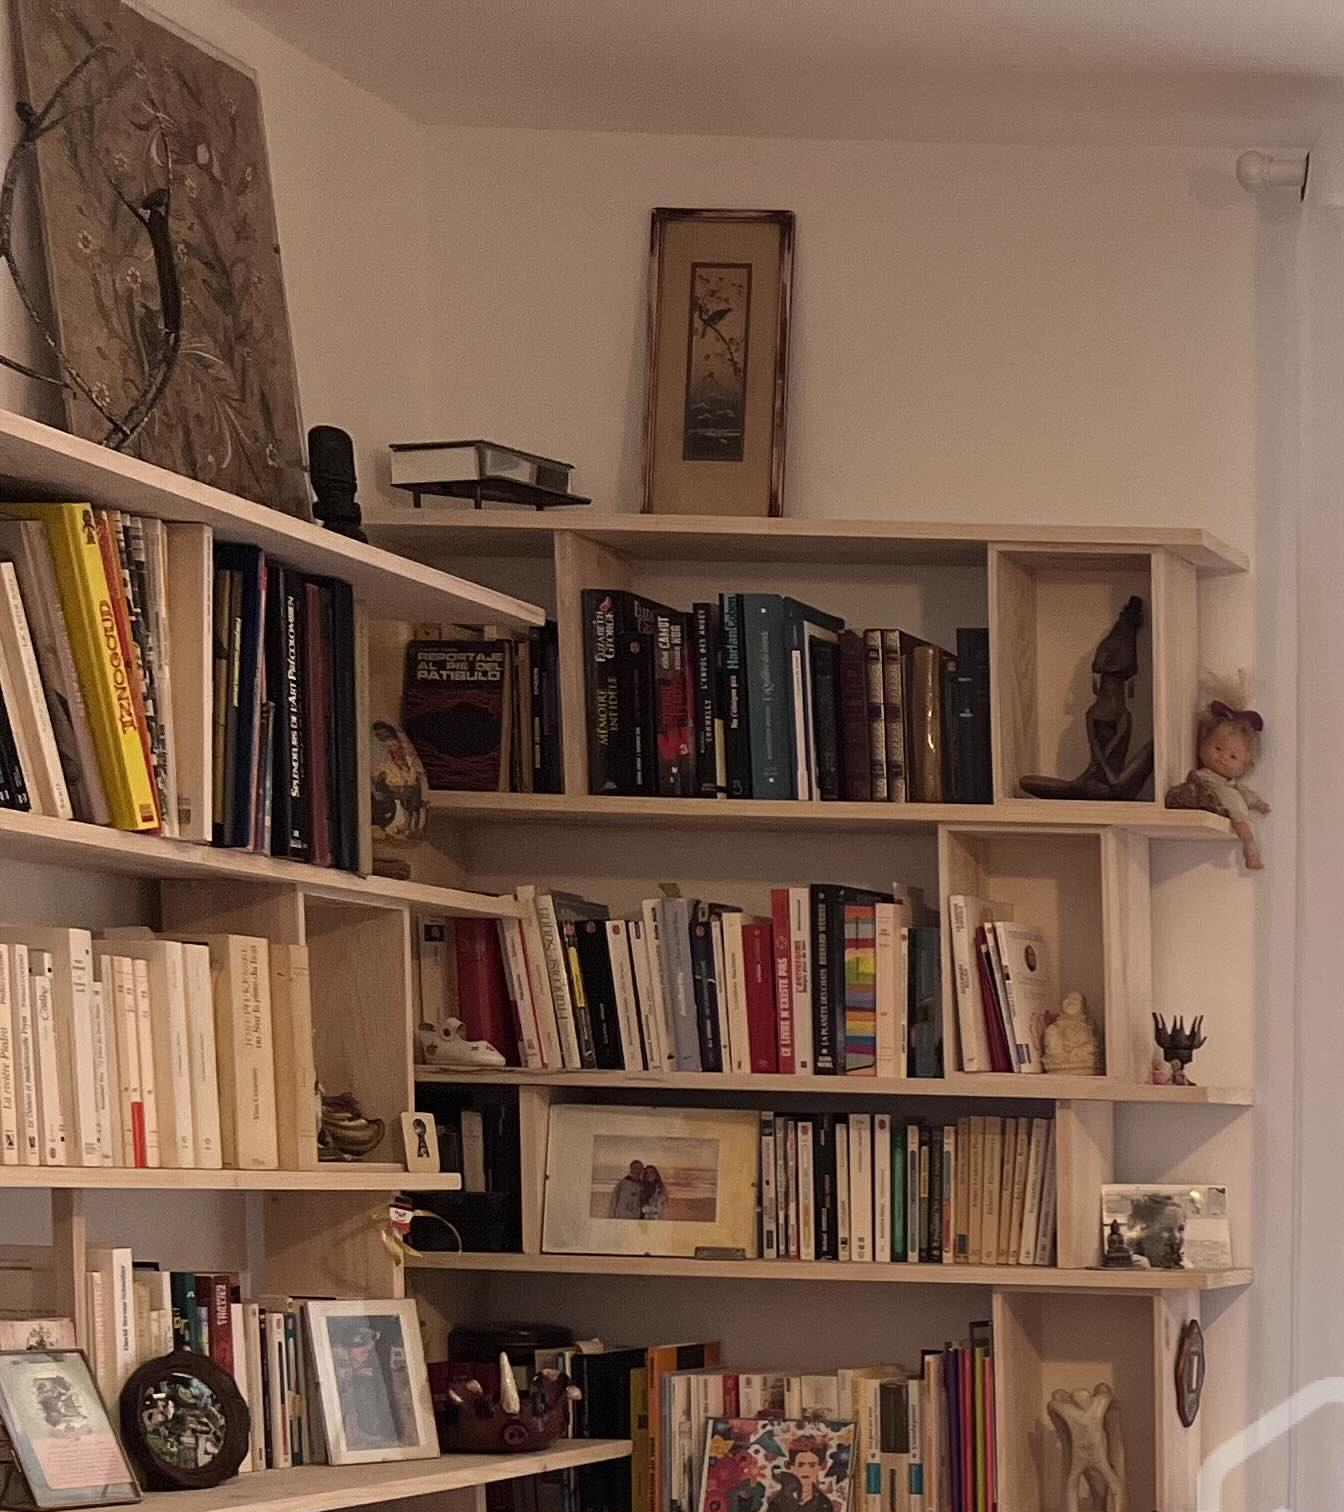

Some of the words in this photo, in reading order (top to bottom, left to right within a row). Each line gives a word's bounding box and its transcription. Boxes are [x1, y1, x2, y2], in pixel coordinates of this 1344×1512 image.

[593, 611, 606, 662] ELIZABETH
[603, 611, 616, 659] GEORGE
[658, 616, 670, 649] CAMUT
[699, 637, 707, 654] DES
[416, 652, 504, 662] REPORTAJE
[726, 628, 740, 670] Harlan
[99, 600, 136, 735] IZNOGOUD
[416, 661, 438, 670] AL
[446, 661, 470, 670] PIE
[475, 661, 504, 670] DEL
[416, 670, 501, 681] PATIBULO
[699, 656, 708, 690] L'ENVOL
[290, 714, 299, 729] DE
[596, 688, 609, 746] MÉMOIRE
[704, 699, 713, 743] CONNELLY
[290, 731, 301, 798] SPLENDEURS
[818, 934, 828, 966] BERNARD
[777, 957, 788, 977] PAS
[38, 984, 50, 1021] Coelho
[779, 978, 790, 1019] N'EXISTE
[820, 993, 828, 1005] DES
[21, 1015, 31, 1035] Prym
[252, 1016, 262, 1033] Sur
[780, 1020, 792, 1044] LIVRE
[0, 1026, 9, 1060] Piedra
[780, 1046, 792, 1057] CE
[820, 1036, 830, 1046] LA
[1, 1063, 11, 1094] rivière
[2, 1096, 12, 1110] La
[121, 1328, 130, 1352] David
